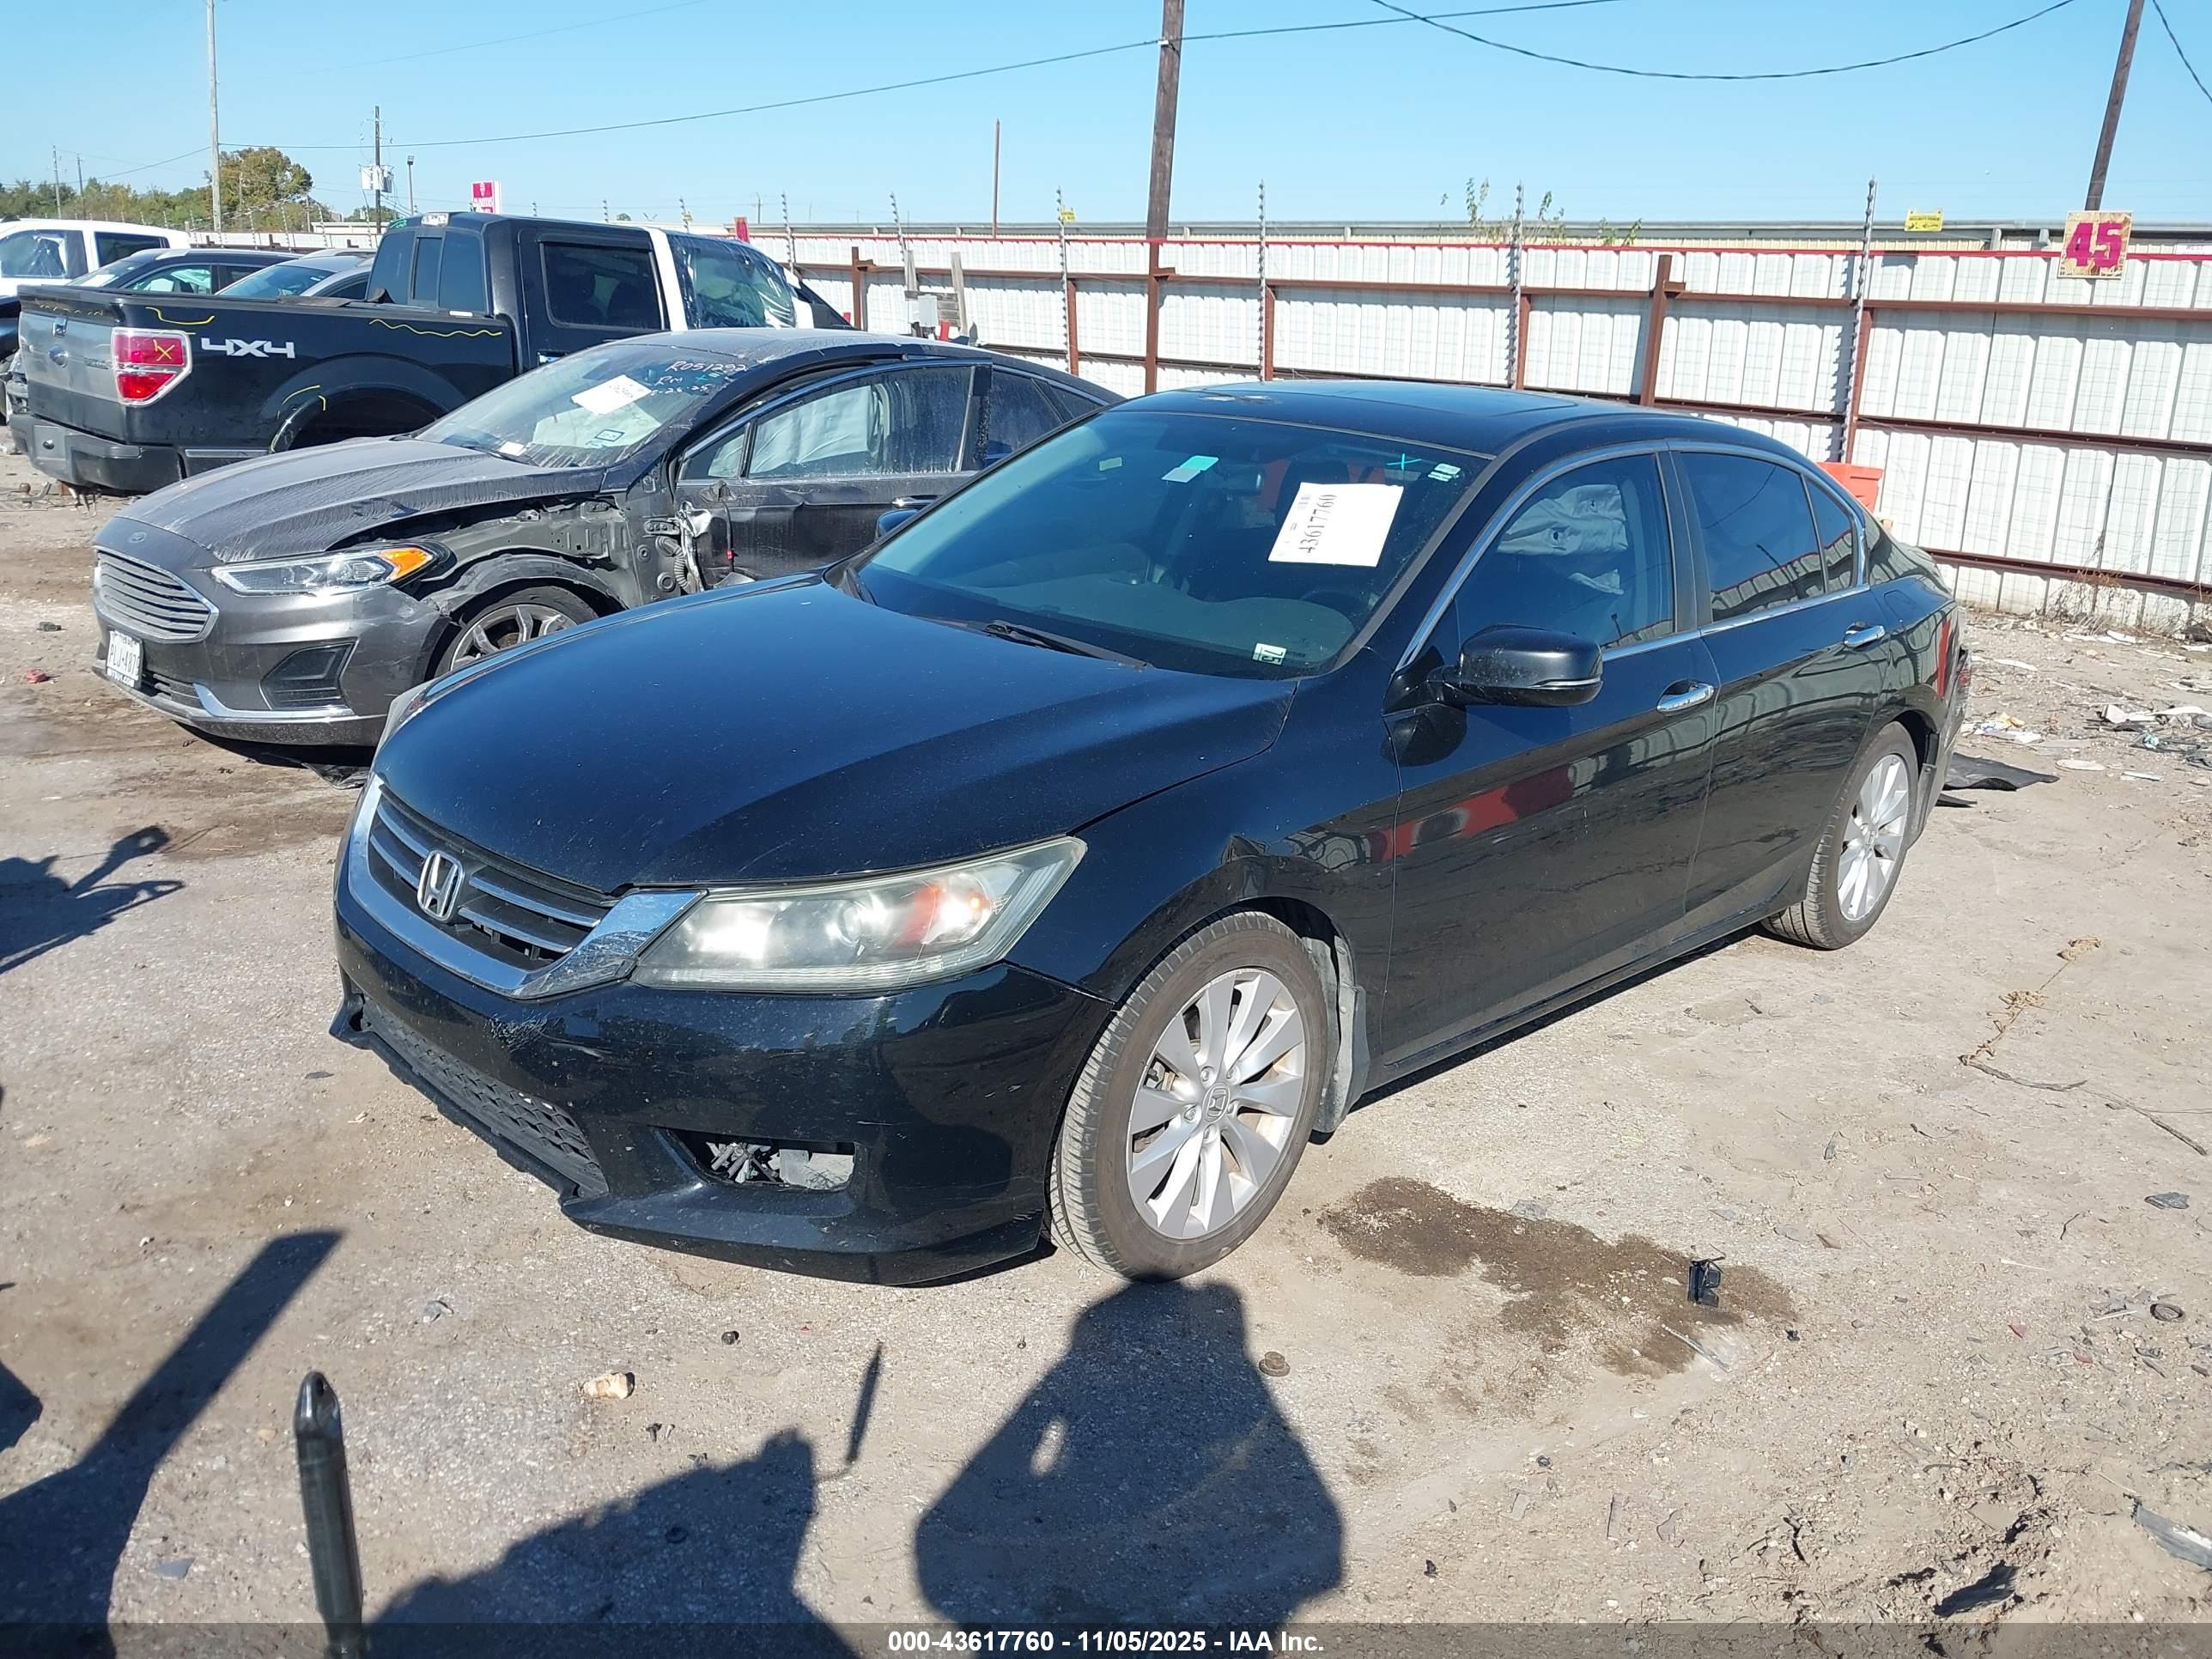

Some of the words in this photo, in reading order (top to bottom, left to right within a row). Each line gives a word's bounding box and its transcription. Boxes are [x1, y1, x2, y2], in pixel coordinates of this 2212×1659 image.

[2065, 220, 2123, 269] 45
[200, 337, 296, 359] 4X4
[1298, 494, 1338, 554] 43617760
